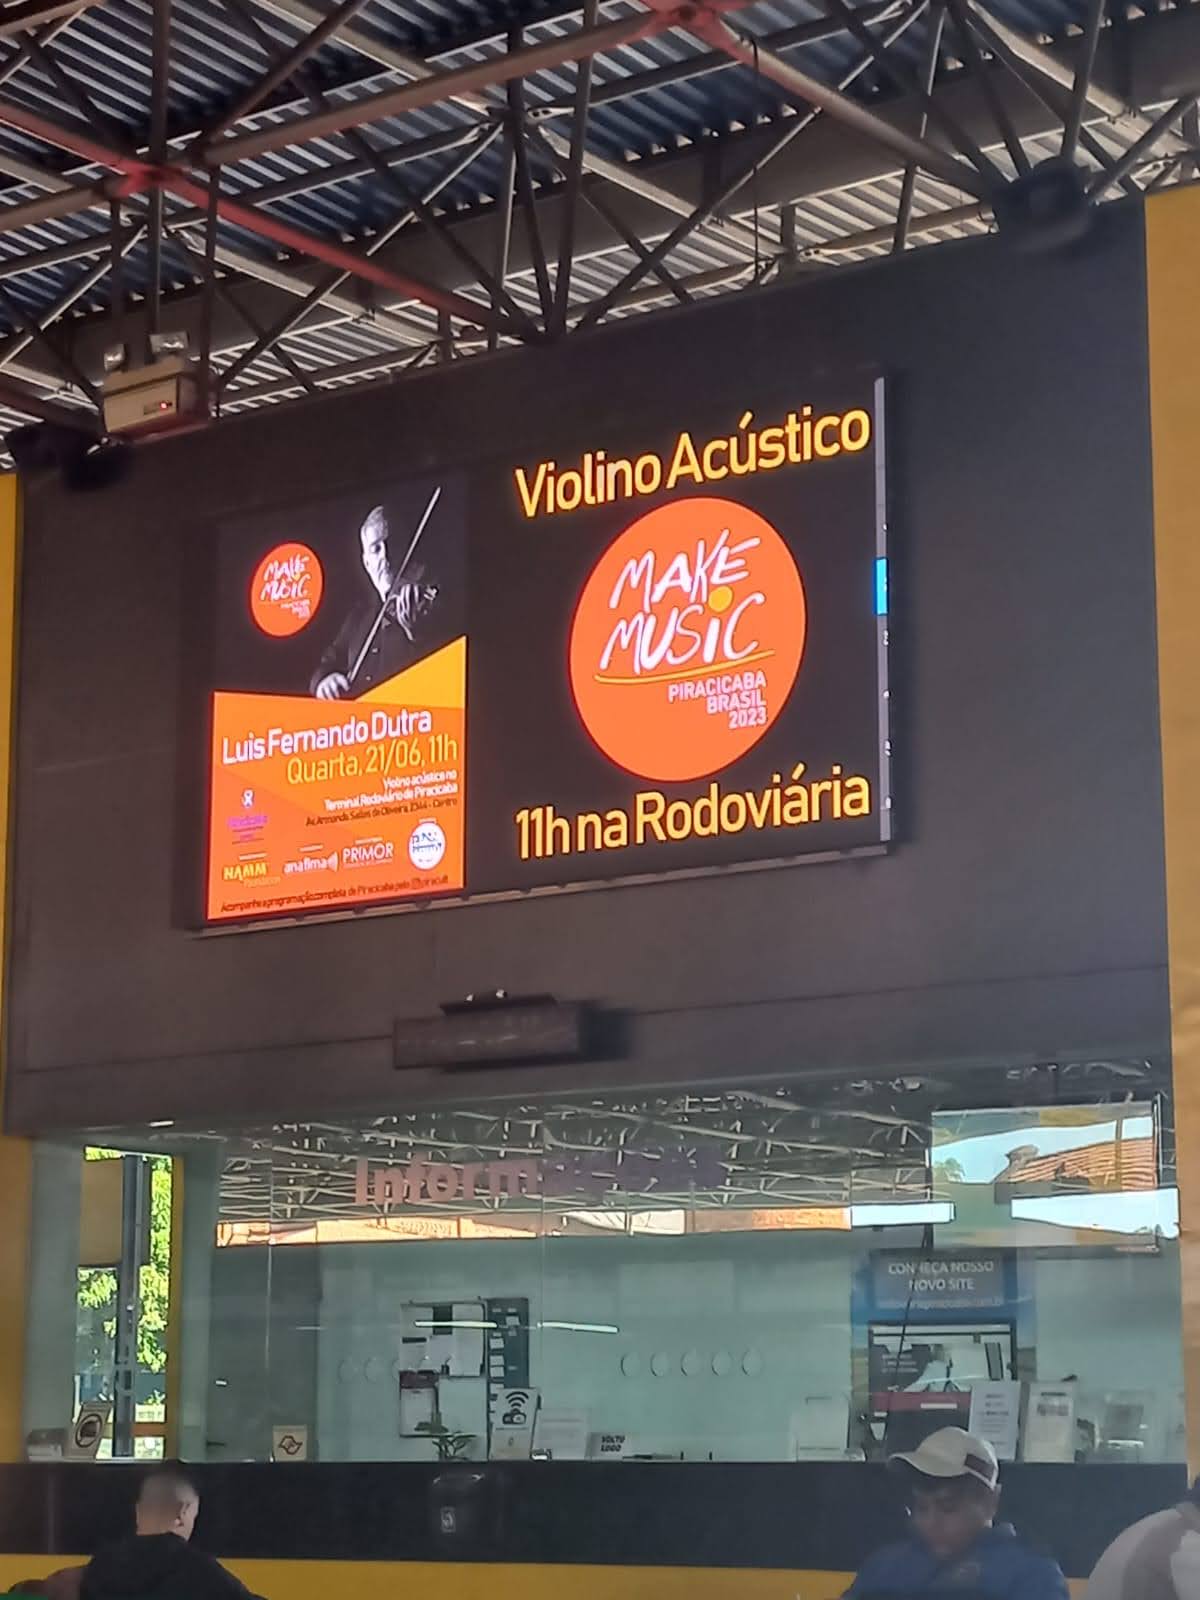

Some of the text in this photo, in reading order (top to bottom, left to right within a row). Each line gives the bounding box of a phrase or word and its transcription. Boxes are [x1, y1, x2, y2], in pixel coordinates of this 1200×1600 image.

[515, 405, 871, 517] Violino Acústico
[608, 528, 761, 609] MAKE
[668, 670, 767, 702] PIRACICABA
[706, 691, 767, 715] BRASIL
[222, 708, 432, 765] Luis Fernando Dutra
[728, 706, 767, 730] 2023
[287, 733, 459, 785] Quarta, 21/06, 11h
[515, 762, 871, 860] 11h na Rodoviária
[342, 842, 395, 864] PRIMOR
